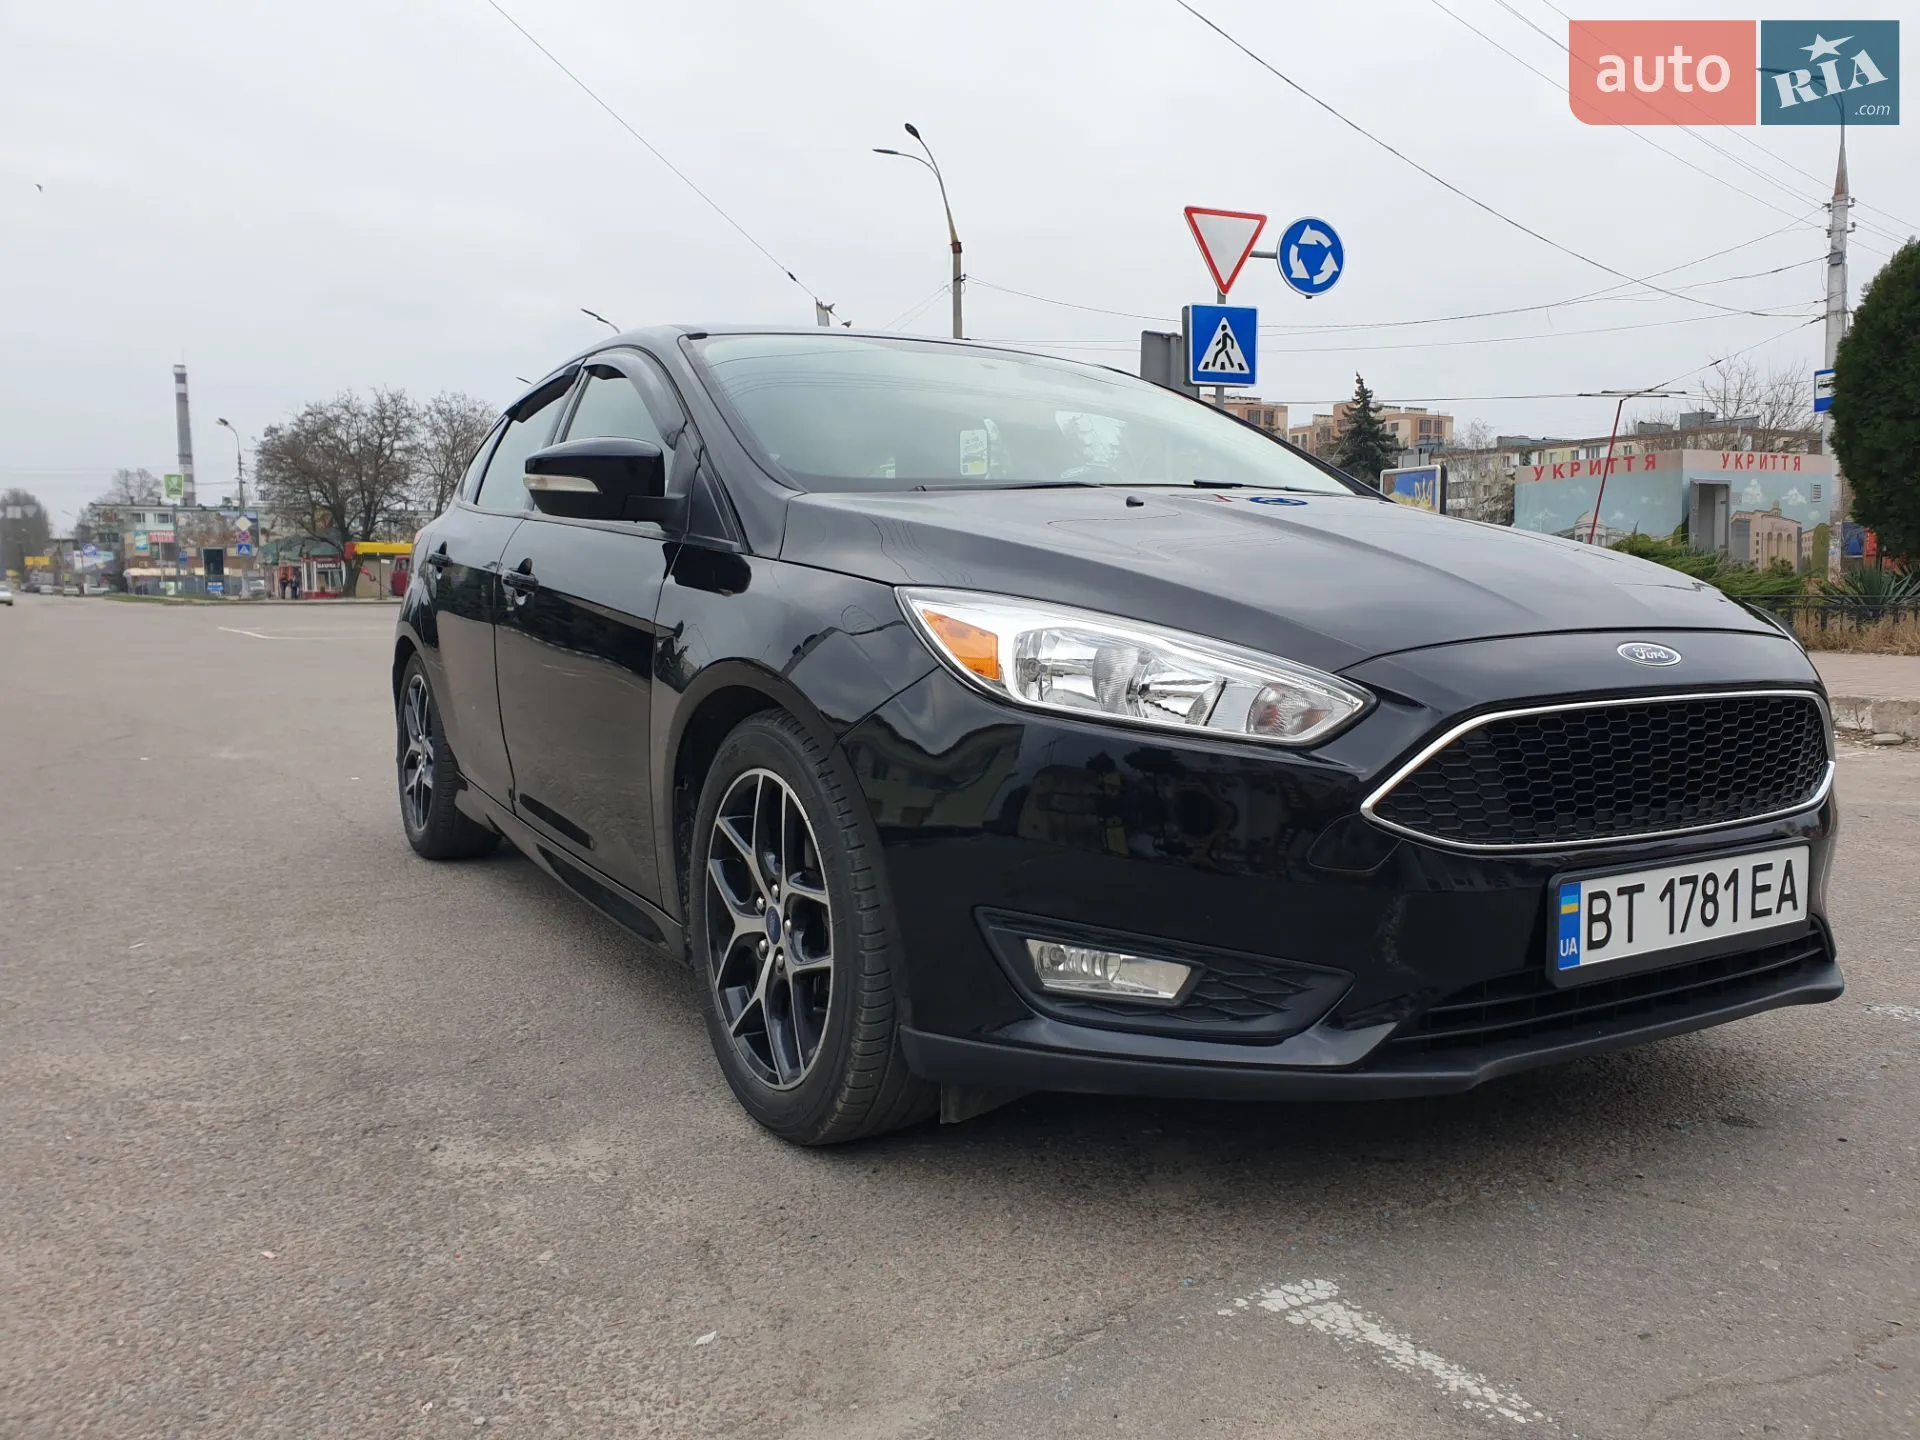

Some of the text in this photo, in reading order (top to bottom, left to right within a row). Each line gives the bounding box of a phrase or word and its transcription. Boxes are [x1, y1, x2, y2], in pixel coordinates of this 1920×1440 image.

[1533, 453, 1657, 482] УКРИТТЯ
[1721, 452, 1801, 472] УКРИТТЯ
[1632, 646, 1669, 660] Ford
[1586, 858, 1799, 951] BT 1781 EA
[1559, 936, 1578, 957] UA
